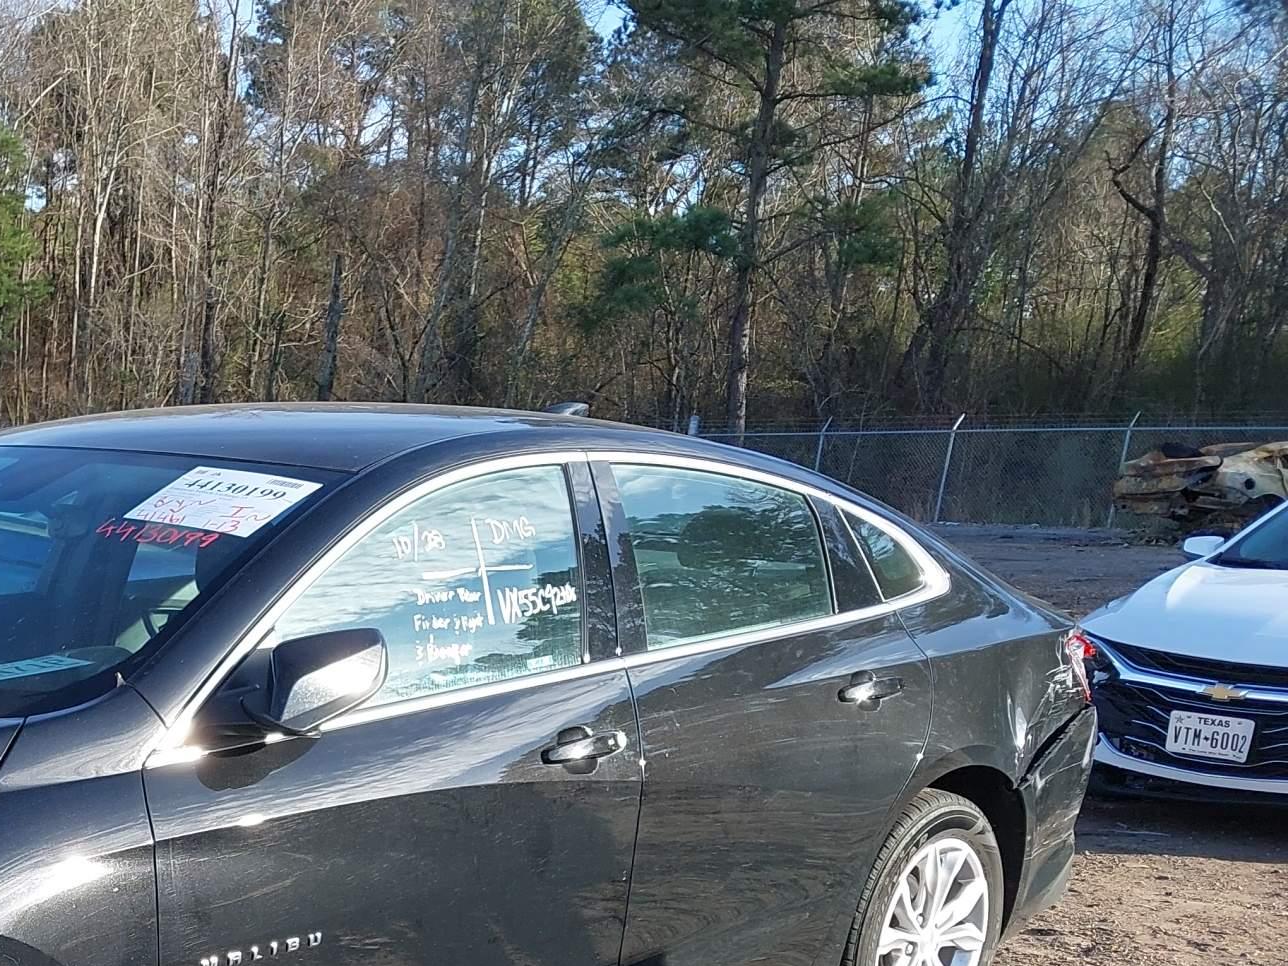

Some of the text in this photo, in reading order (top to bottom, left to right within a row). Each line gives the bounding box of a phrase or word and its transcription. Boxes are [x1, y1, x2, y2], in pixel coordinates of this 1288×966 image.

[184, 478, 287, 501] 44130199
[95, 517, 222, 548] 44130199
[485, 516, 536, 545] DMG
[1197, 716, 1231, 728] TEXAS
